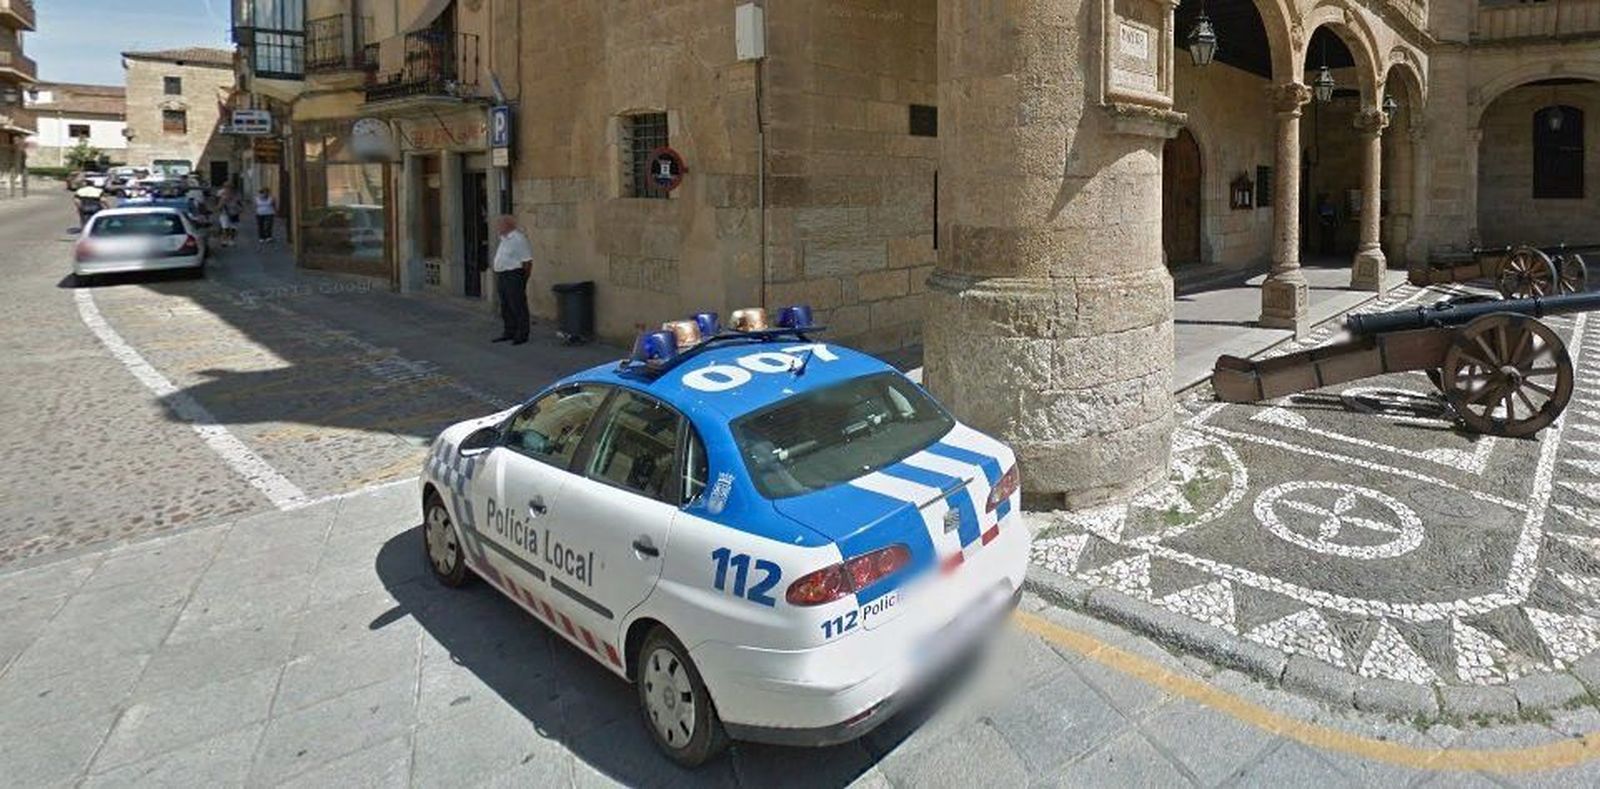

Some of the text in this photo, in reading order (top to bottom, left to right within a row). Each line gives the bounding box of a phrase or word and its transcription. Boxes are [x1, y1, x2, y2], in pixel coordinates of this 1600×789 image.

[495, 111, 505, 142] P
[681, 344, 840, 392] 007
[487, 497, 594, 587] Policía Local
[712, 547, 783, 607] 112
[820, 610, 859, 640] 112
